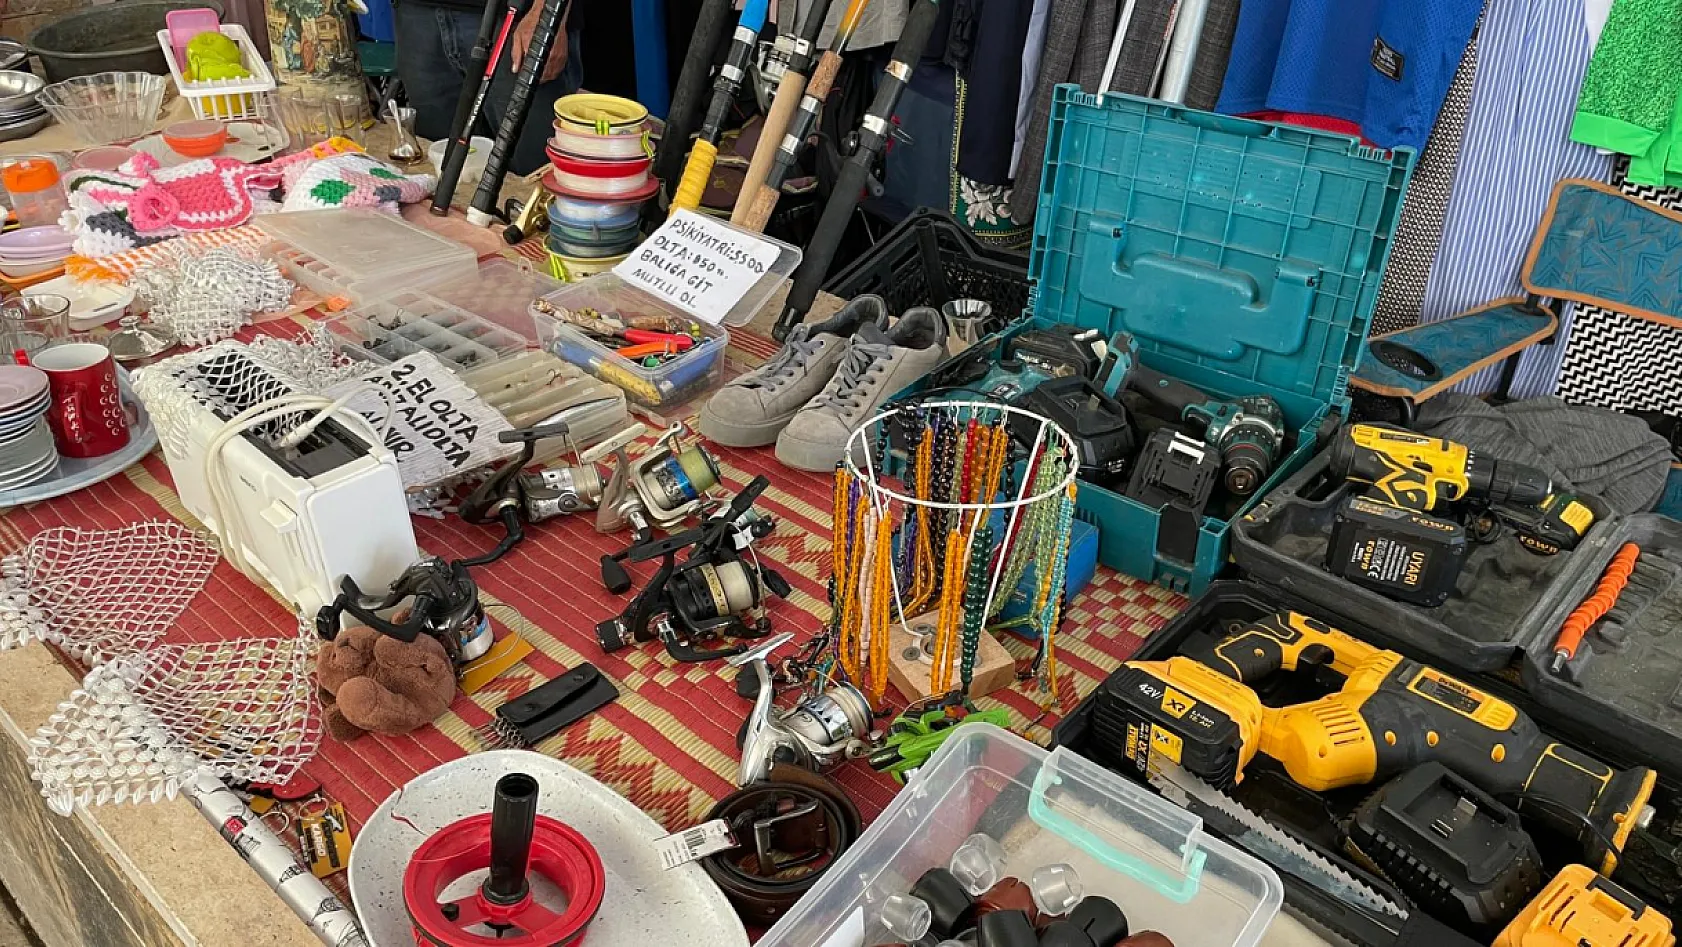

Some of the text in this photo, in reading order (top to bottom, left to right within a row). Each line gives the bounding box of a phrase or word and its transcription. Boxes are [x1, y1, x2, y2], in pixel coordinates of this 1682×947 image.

[632, 268, 677, 296] MUTLU
[687, 274, 713, 294] GİT
[429, 400, 478, 444] OLTA
[1404, 551, 1426, 586] UYARI
[1166, 698, 1187, 713] XR
